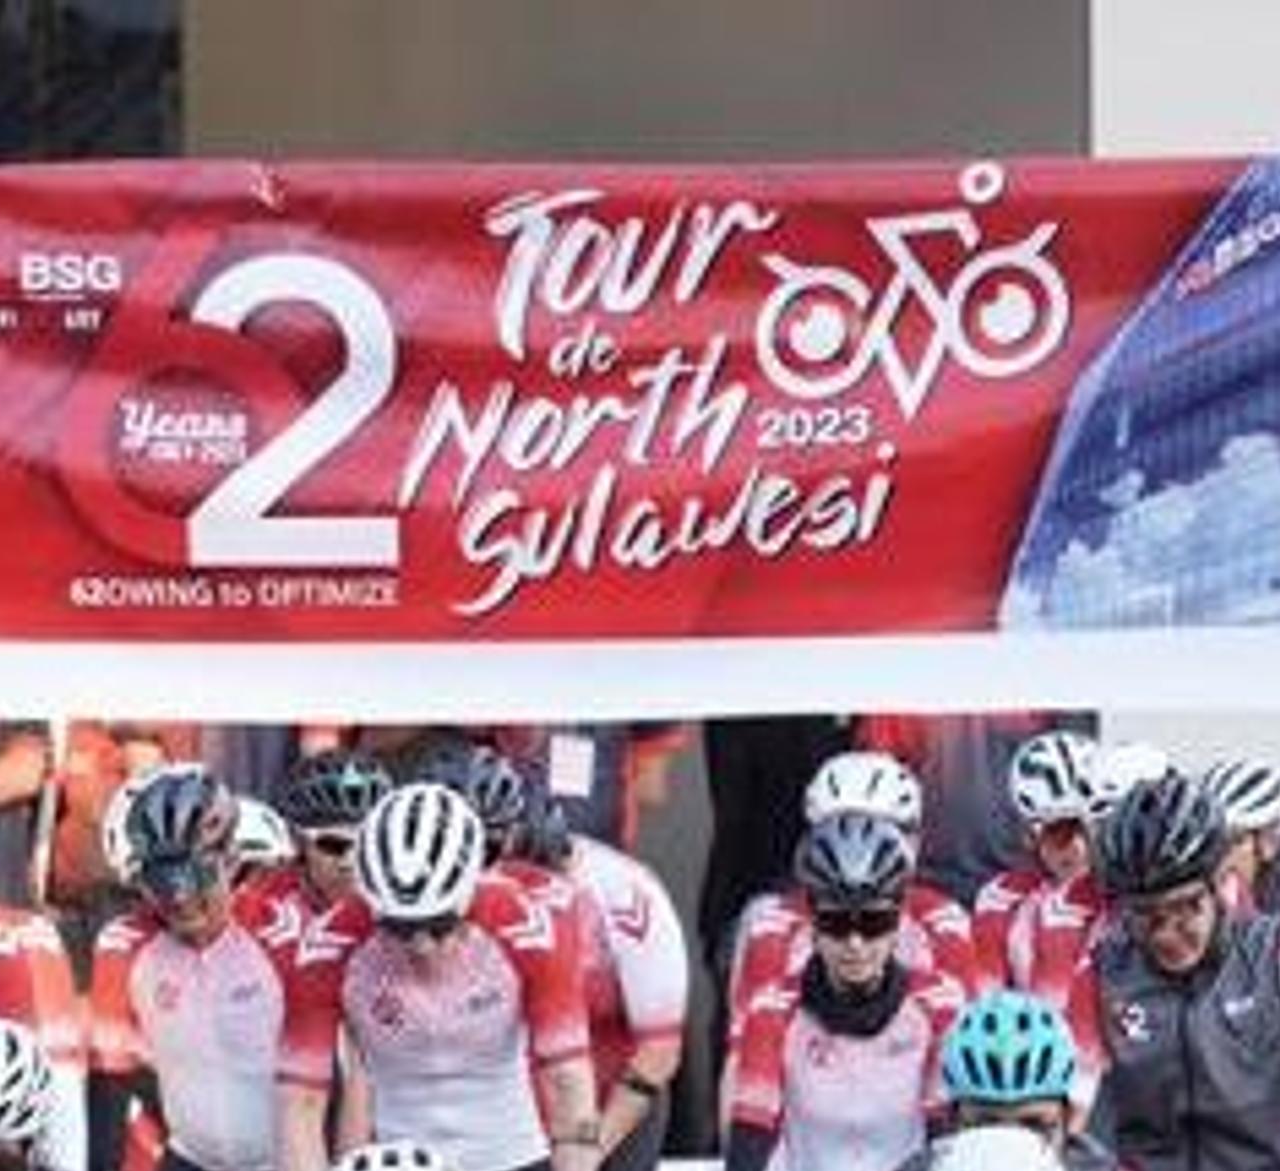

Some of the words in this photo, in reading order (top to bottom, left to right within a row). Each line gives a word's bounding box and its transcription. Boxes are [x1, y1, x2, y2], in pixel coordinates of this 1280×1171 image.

[20, 254, 120, 291] BSG
[485, 190, 778, 361] Tour
[549, 322, 618, 378] de
[398, 335, 749, 510] North
[756, 407, 872, 448] 2023
[453, 442, 896, 616] Sulawesi
[220, 578, 252, 605] to
[257, 577, 400, 607] OPTIMIZE
